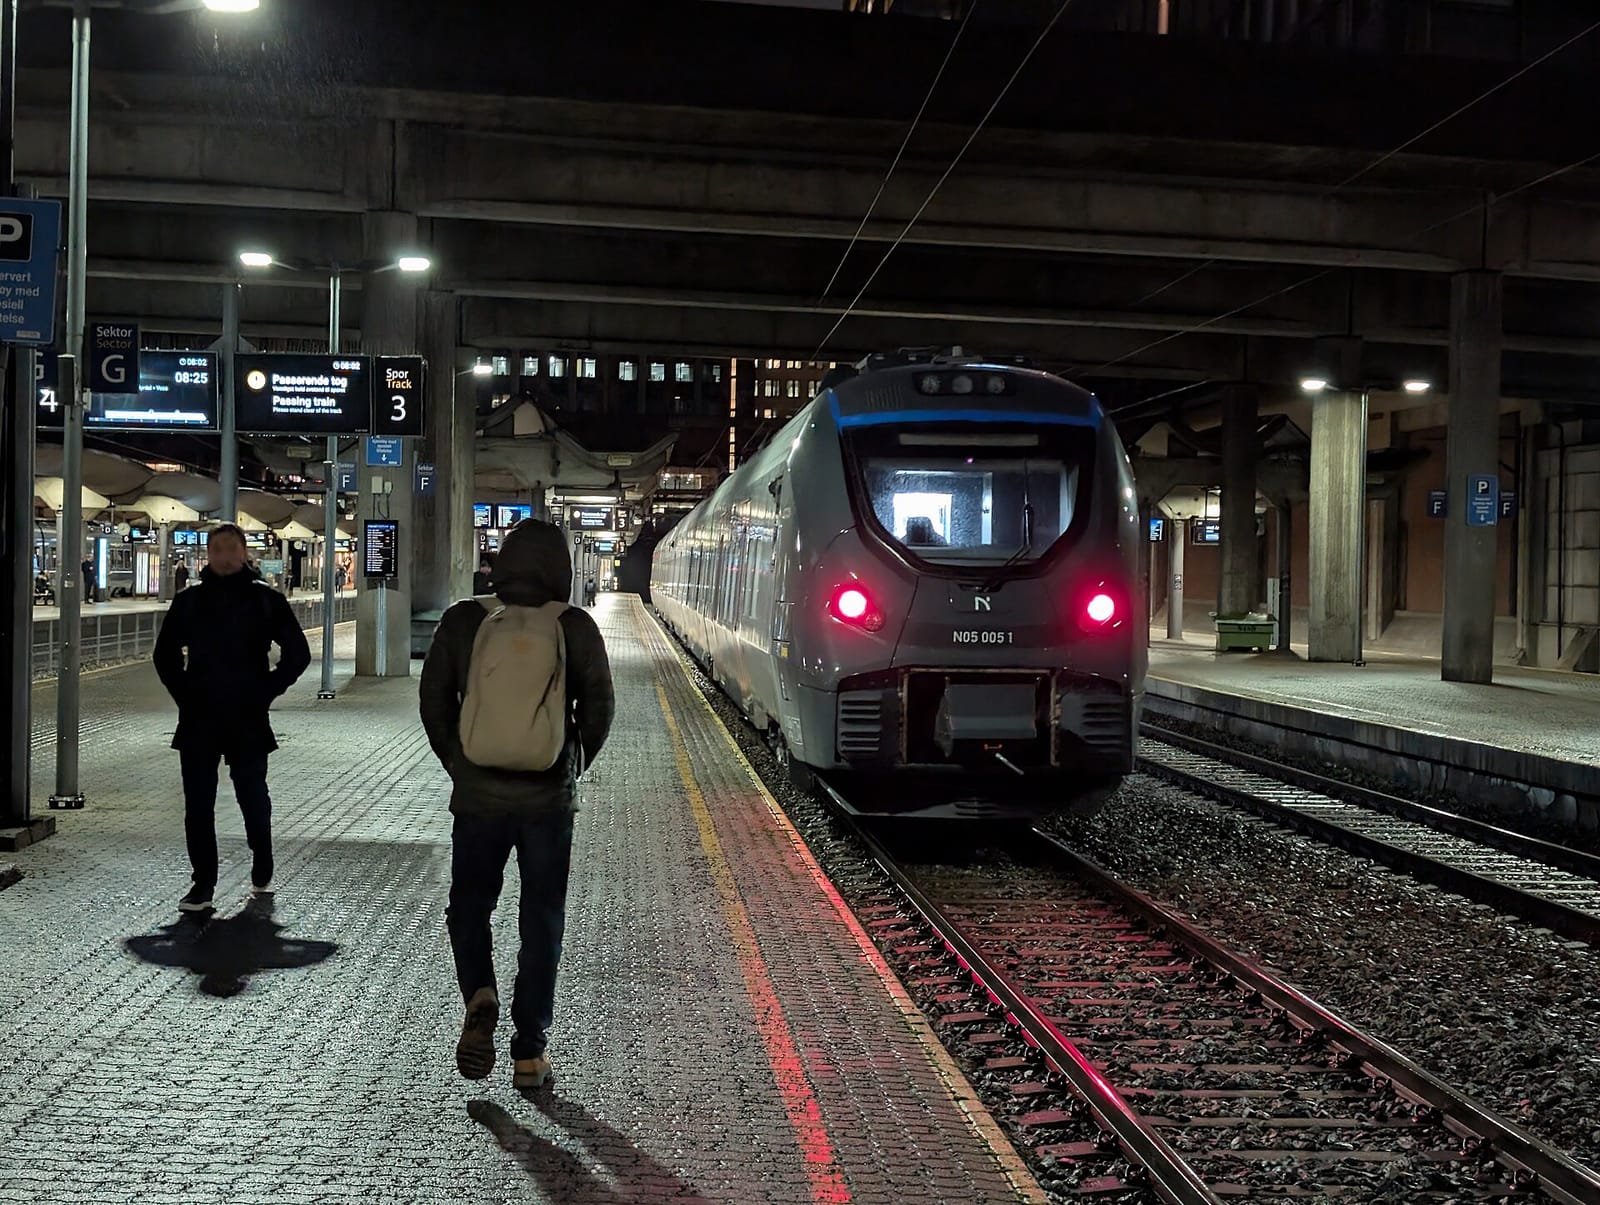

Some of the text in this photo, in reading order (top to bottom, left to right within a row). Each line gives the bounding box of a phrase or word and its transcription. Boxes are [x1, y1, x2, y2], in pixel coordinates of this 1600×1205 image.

[15, 286, 40, 297] med
[96, 326, 132, 338] Sektor
[96, 338, 132, 349] Sector
[187, 358, 208, 366] 08:02
[101, 354, 126, 383] G
[386, 368, 409, 380] Spor
[175, 371, 209, 384] 08:25
[272, 373, 348, 388] Passerende tog
[385, 379, 413, 389] Track
[272, 395, 336, 408] Passing train
[390, 395, 406, 421] 3
[342, 475, 350, 488] F
[421, 477, 429, 491] F
[1478, 481, 1488, 493] P
[1433, 501, 1442, 514] F
[1503, 502, 1511, 515] F
[618, 518, 625, 528] 3
[953, 631, 979, 643] N05
